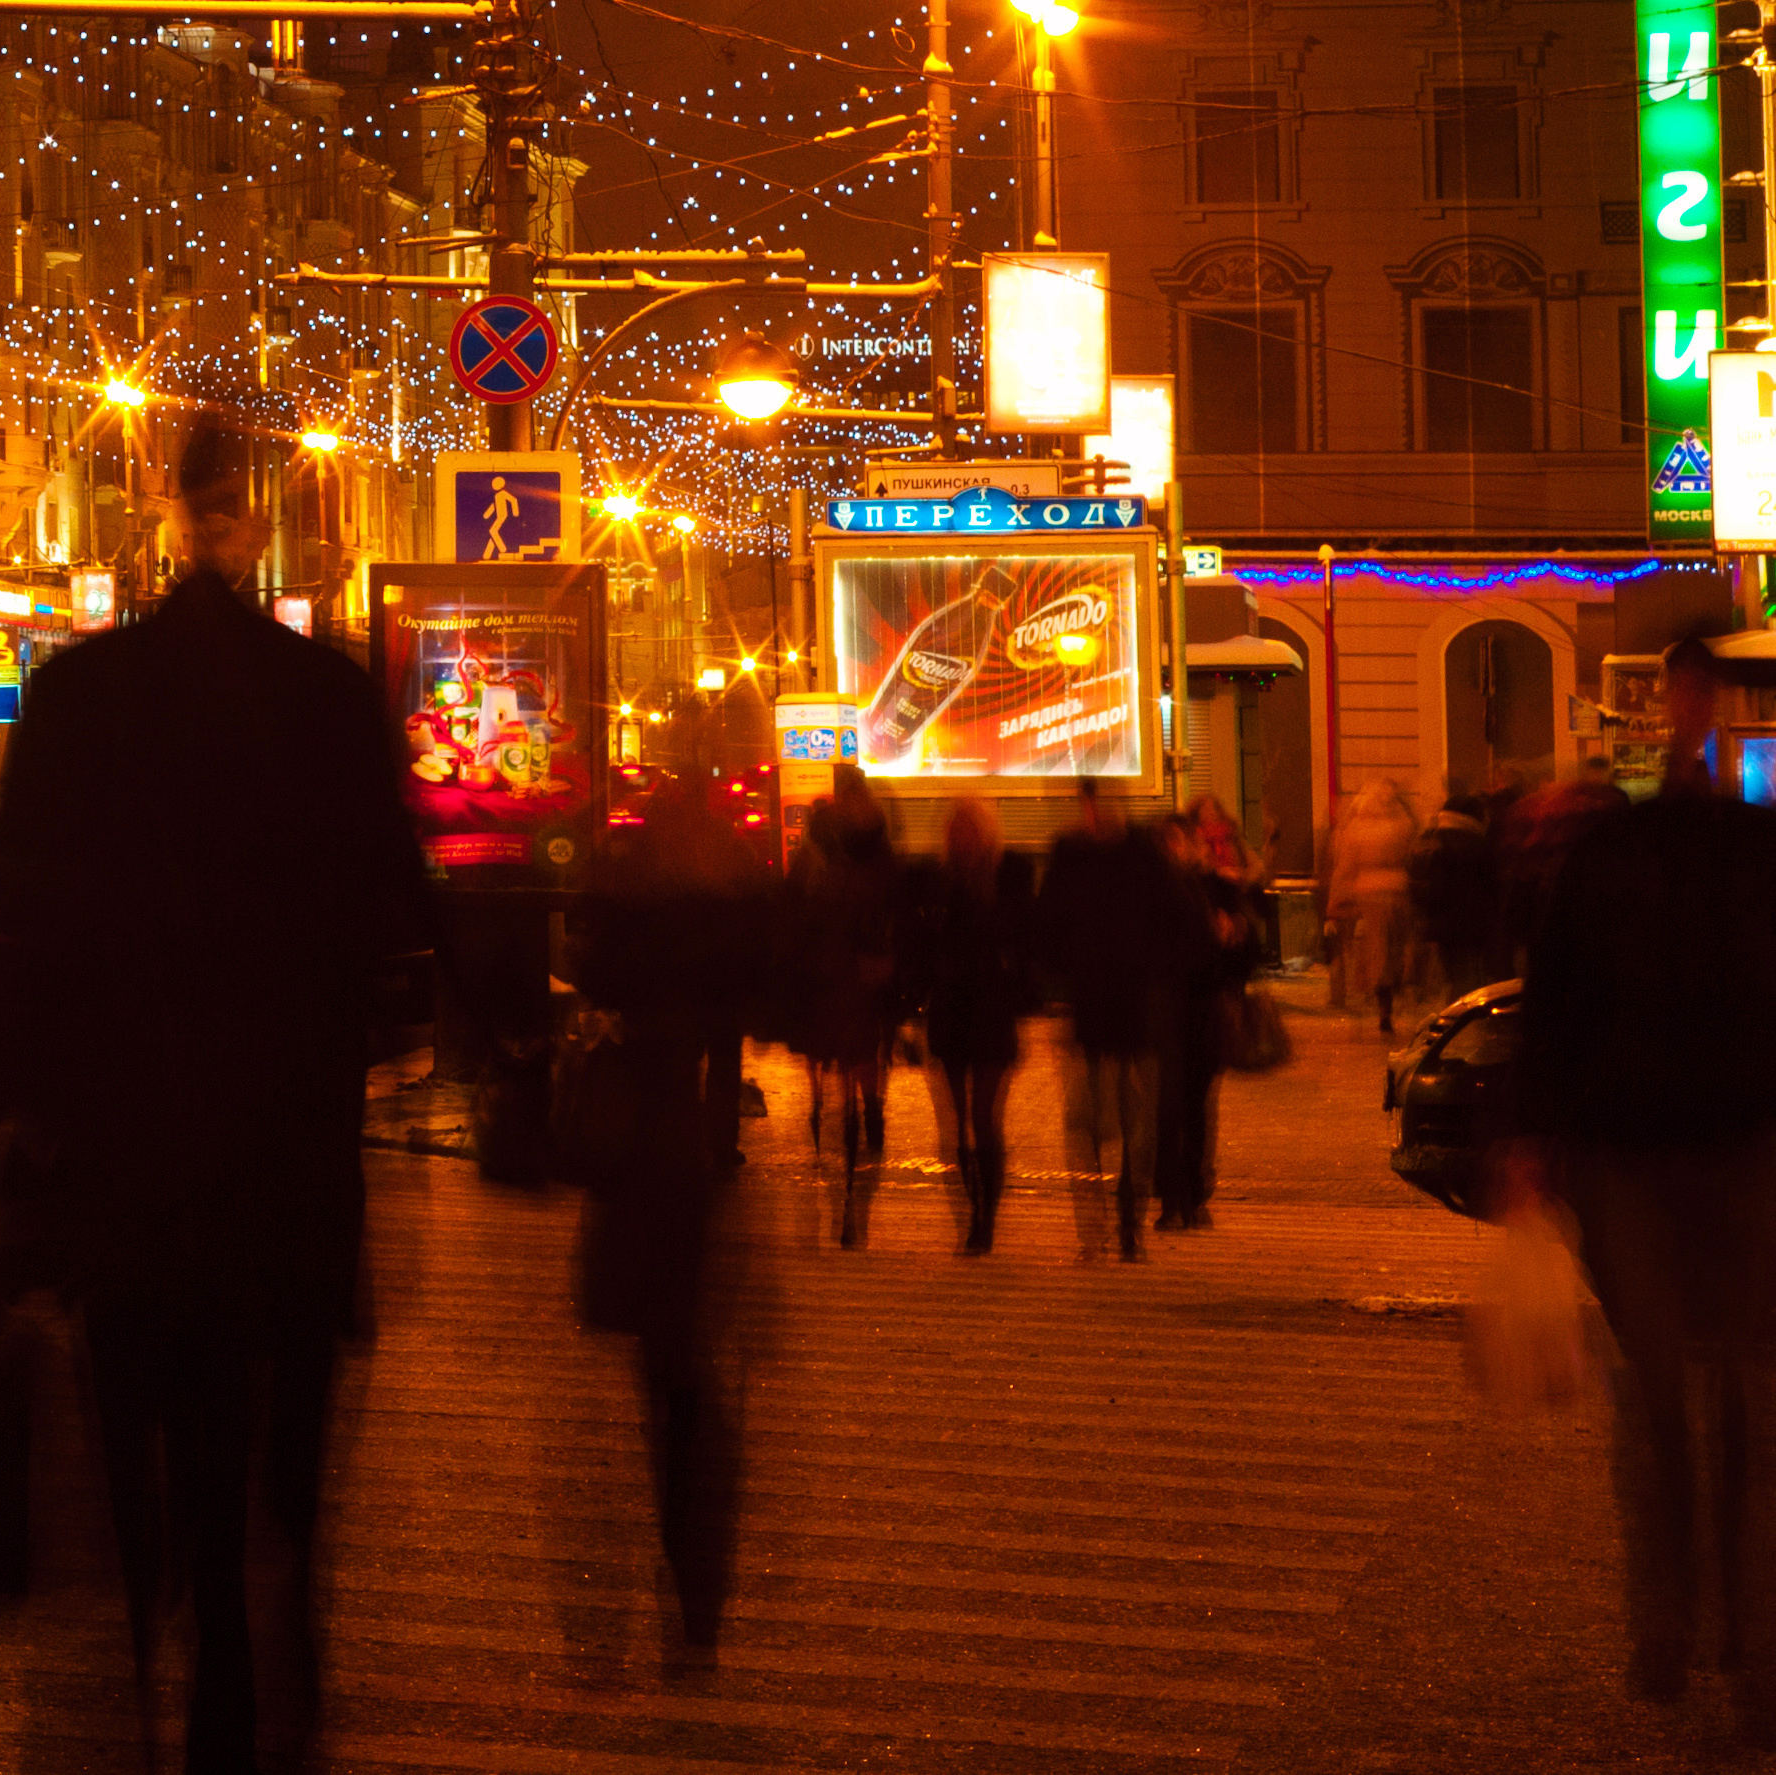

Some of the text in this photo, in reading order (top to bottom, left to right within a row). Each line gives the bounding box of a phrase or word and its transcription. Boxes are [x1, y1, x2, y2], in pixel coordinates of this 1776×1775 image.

[865, 503, 1106, 527] ПЕРЕХОД
[1654, 509, 1712, 522] МОСКВ
[398, 613, 578, 634] Окутайте дом теплом
[1014, 600, 1107, 649] TORNADO
[998, 697, 1084, 739] ЗАРЯДИСЬ
[1037, 704, 1128, 749] КАК НАДО!
